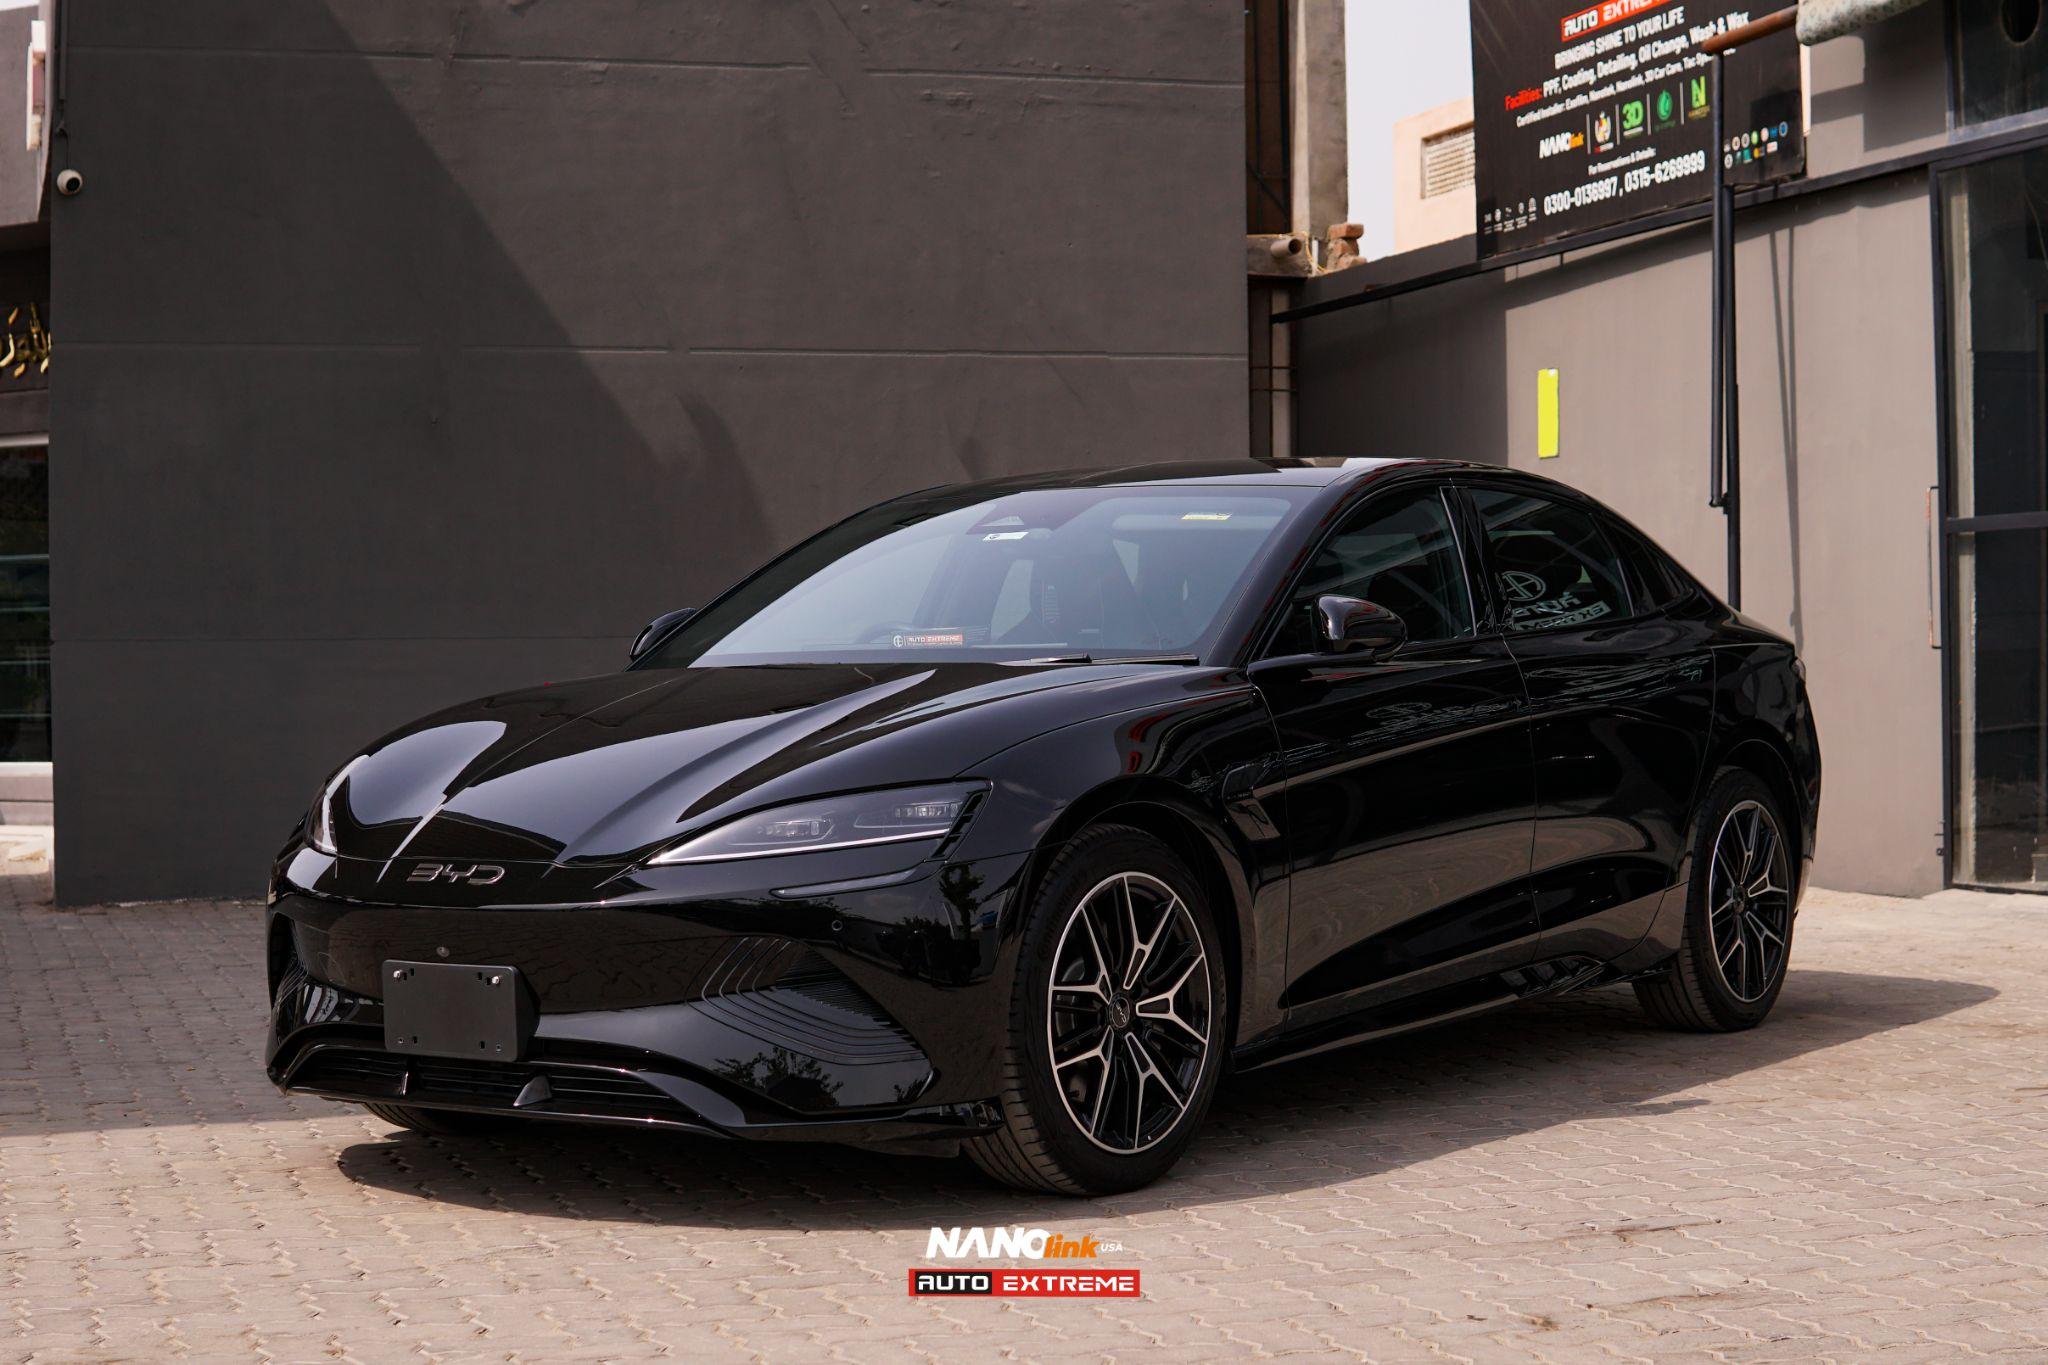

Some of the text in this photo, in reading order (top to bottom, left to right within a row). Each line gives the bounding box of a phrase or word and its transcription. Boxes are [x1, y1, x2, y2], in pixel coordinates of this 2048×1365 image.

[1564, 10, 1599, 37] AUTO
[1595, 29, 1624, 55] SHINE
[1623, 24, 1637, 44] TO
[1636, 14, 1663, 39] YOUR
[1662, 5, 1685, 30] LIFE
[1638, 43, 1651, 63] Oil
[1717, 16, 1727, 36] &
[1622, 100, 1644, 130] 3D
[406, 863, 505, 886] BYD
